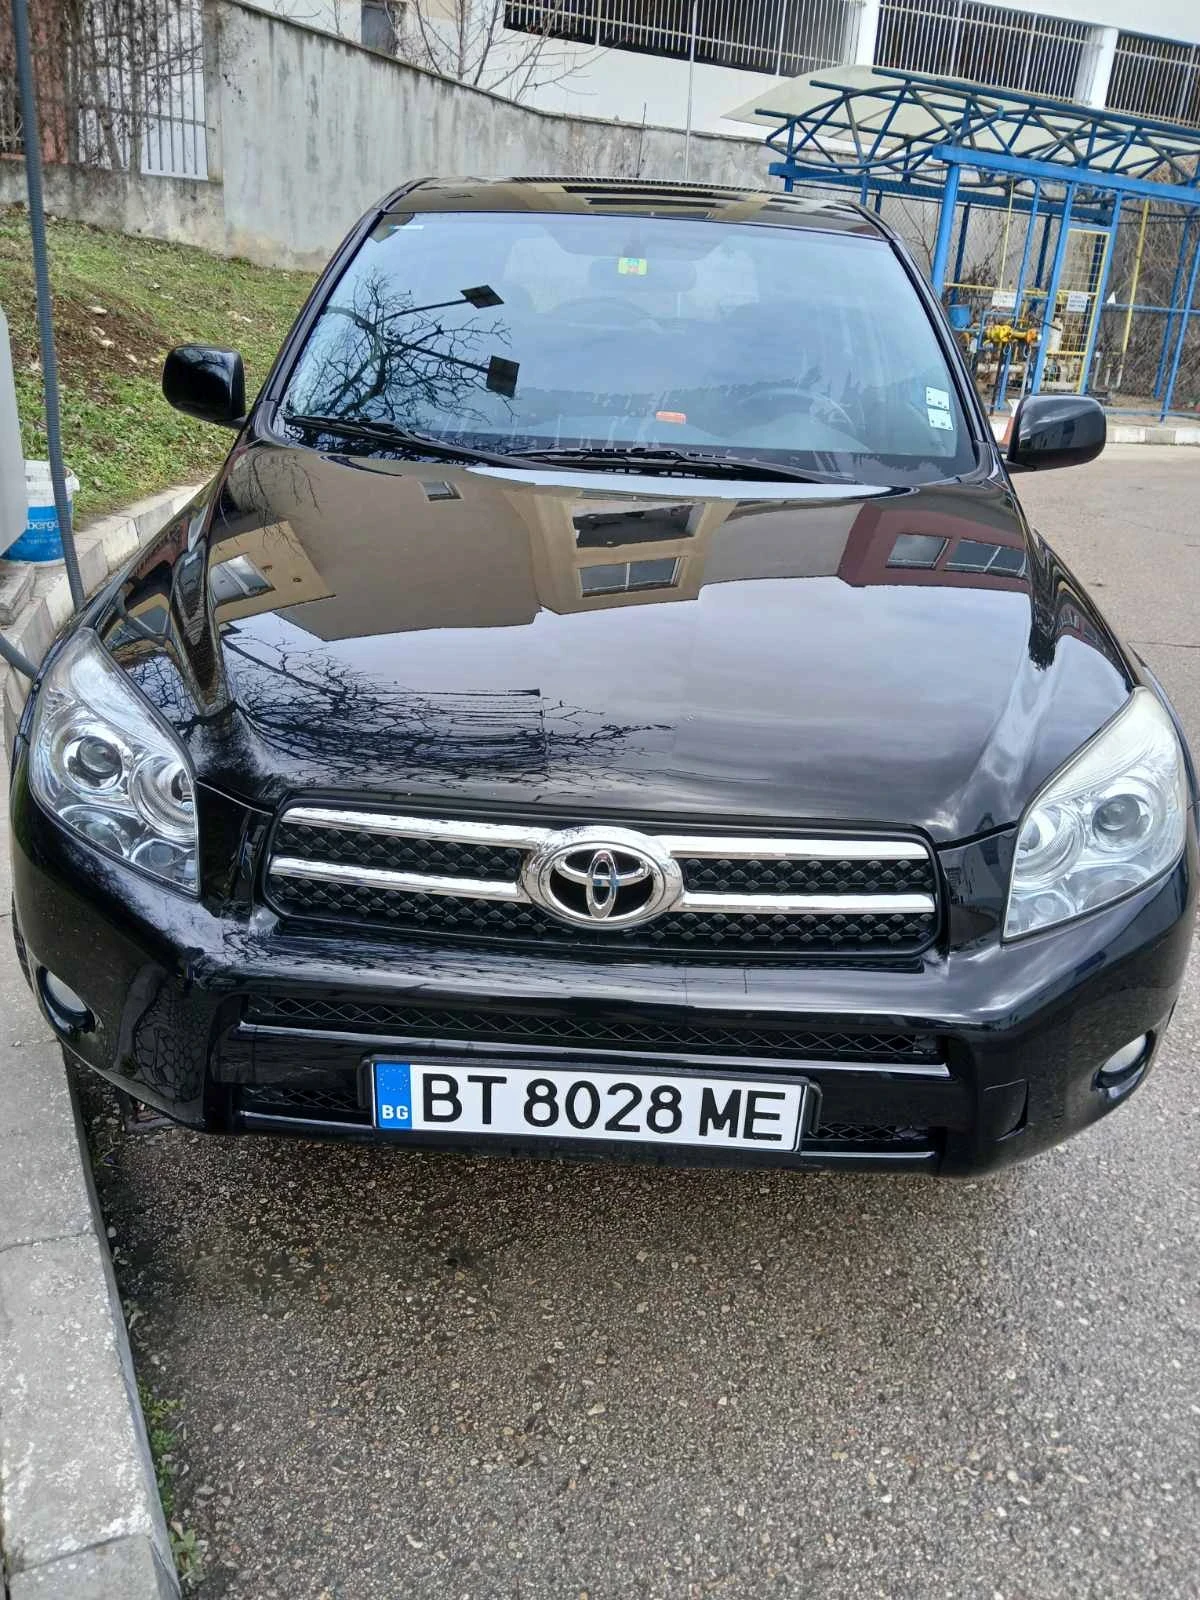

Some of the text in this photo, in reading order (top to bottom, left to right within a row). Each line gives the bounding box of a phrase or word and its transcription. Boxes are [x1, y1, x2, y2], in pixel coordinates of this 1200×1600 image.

[381, 1104, 409, 1120] BG
[422, 1072, 786, 1141] BT 8028 ME
